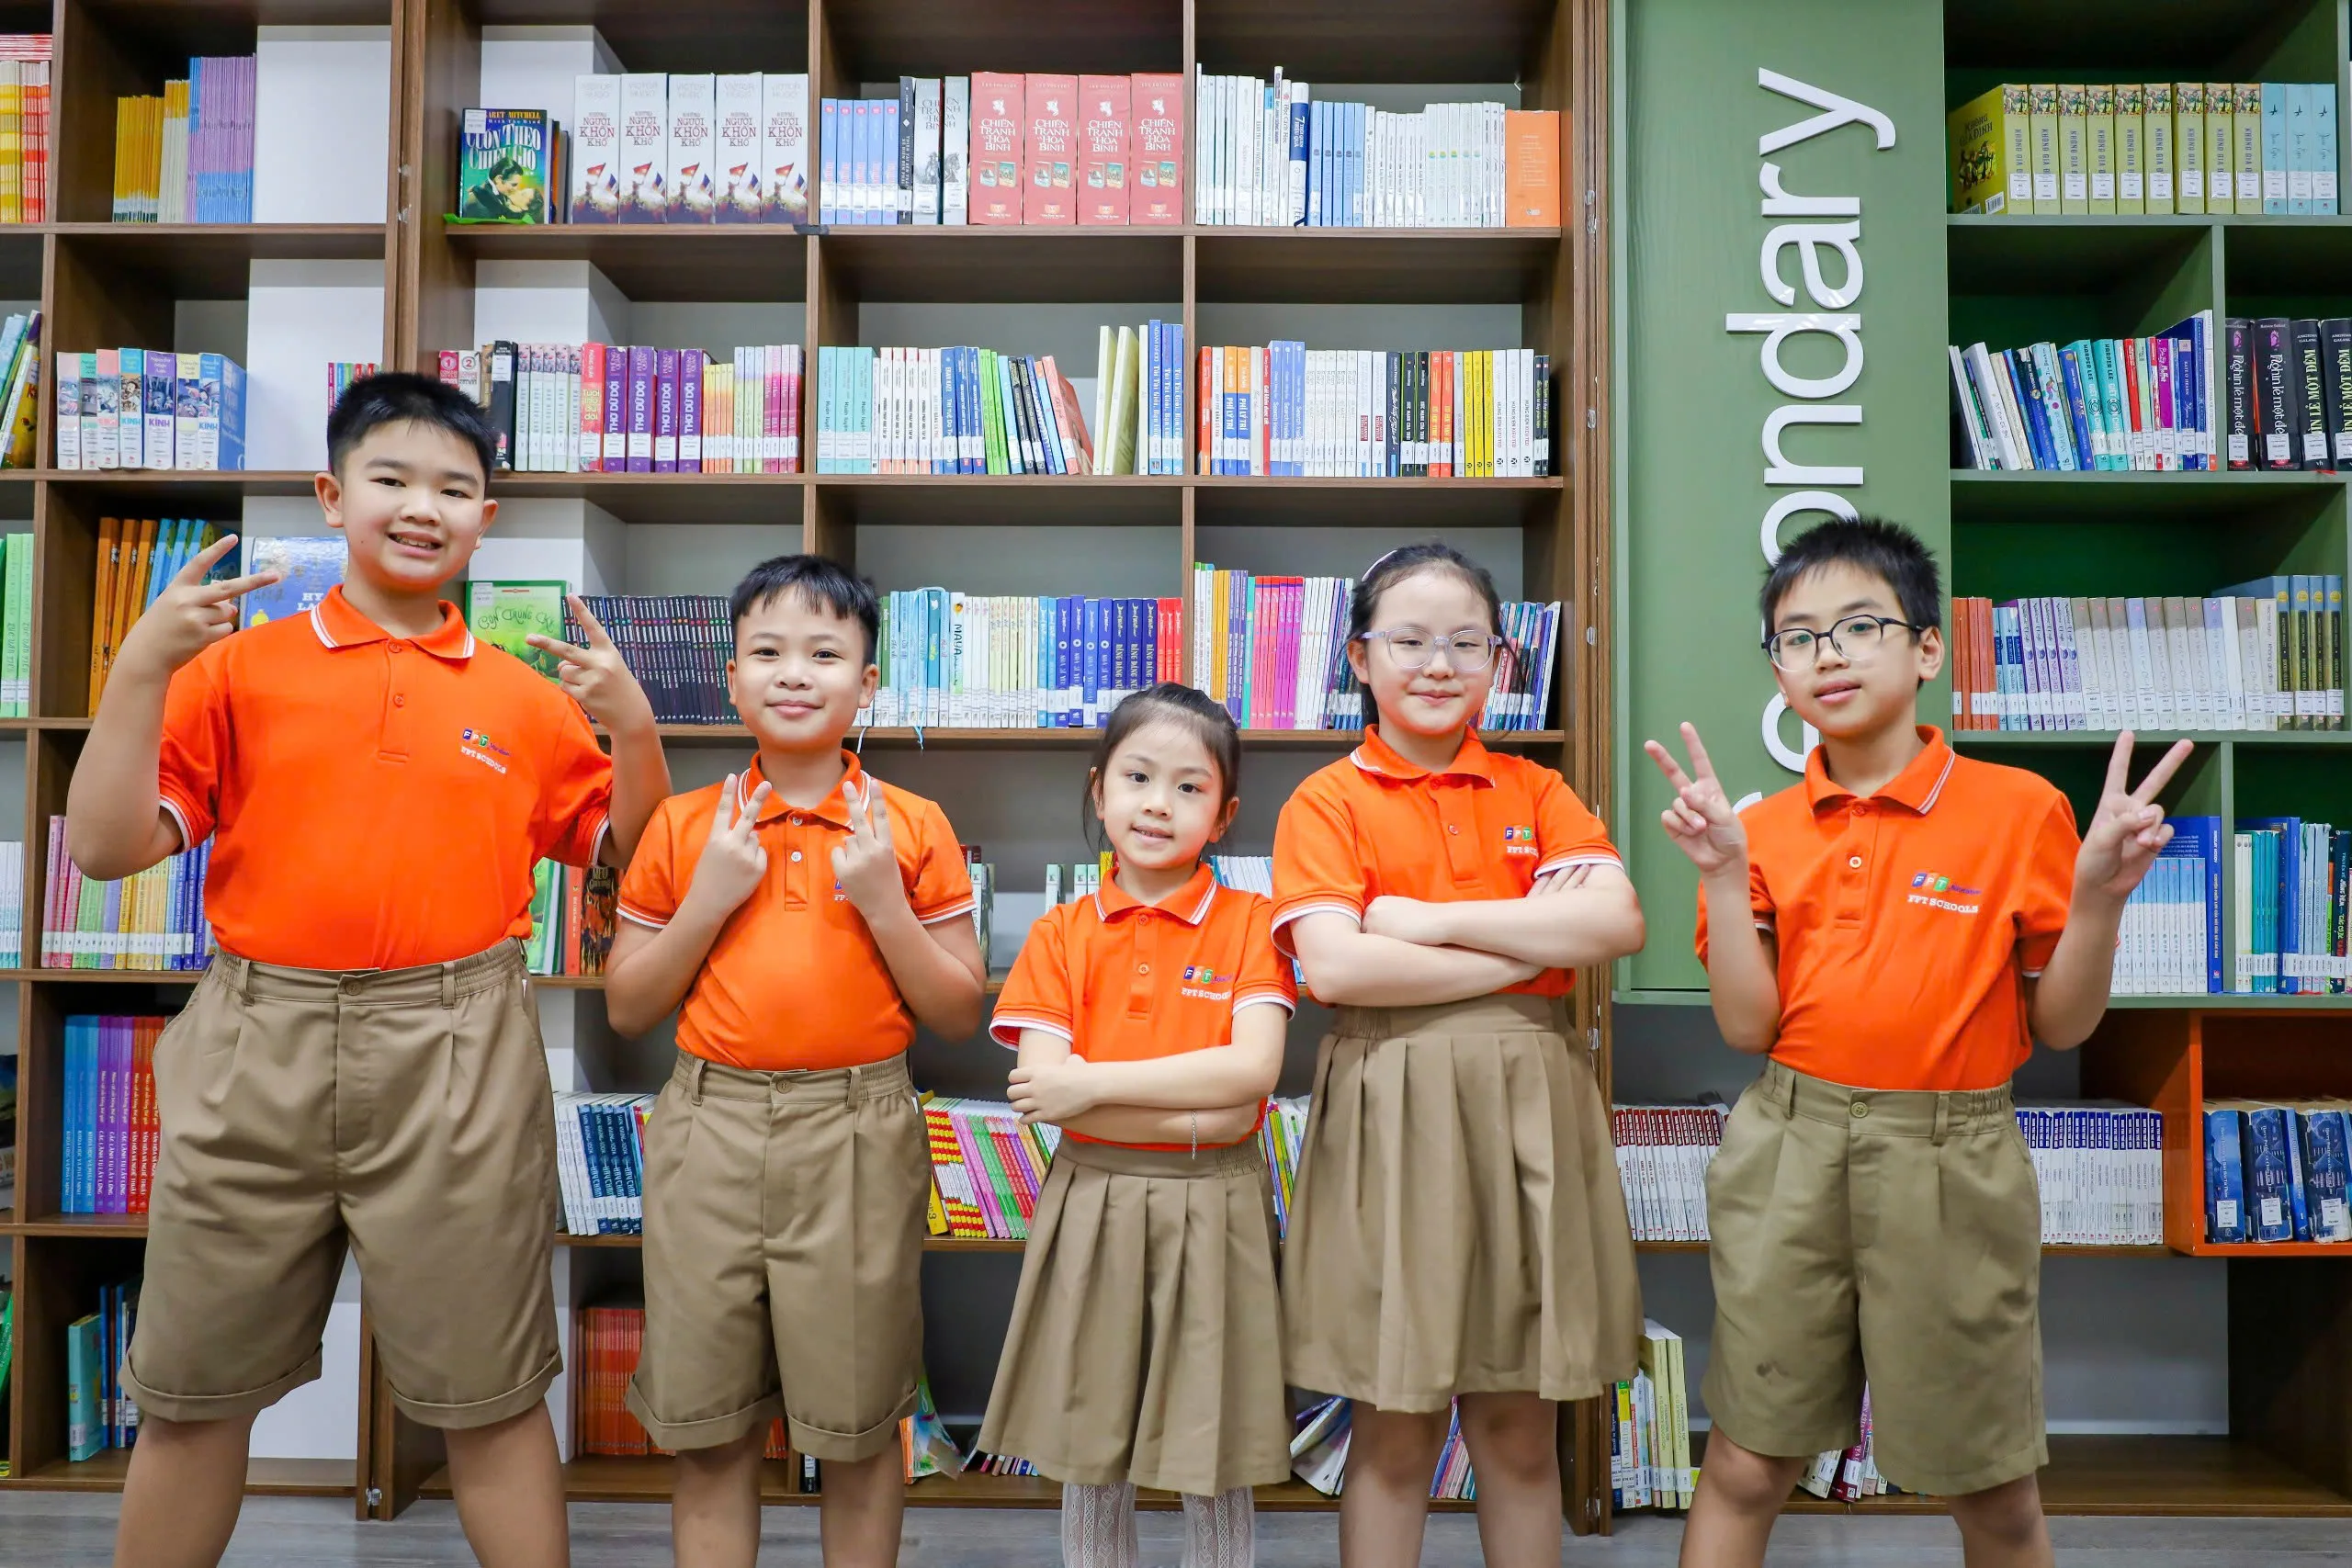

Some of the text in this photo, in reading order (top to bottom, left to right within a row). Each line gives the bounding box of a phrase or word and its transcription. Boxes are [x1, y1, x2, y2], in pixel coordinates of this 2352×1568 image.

[2083, 344, 2091, 368] HARPER
[2104, 344, 2113, 368] HARPER
[1226, 397, 1235, 409] PHÍ
[1238, 398, 1248, 410] PHÍ
[1227, 419, 1235, 430] TRÍ
[1239, 419, 1248, 431] TRÍ
[302, 592, 324, 602] HY
[954, 624, 963, 656] MAYA
[463, 729, 489, 746] FPT
[1505, 828, 1532, 840] FPT
[1913, 874, 1949, 891] FPT
[1908, 895, 1979, 913] FPT SCHOOLS
[1183, 966, 1213, 983] FPT
